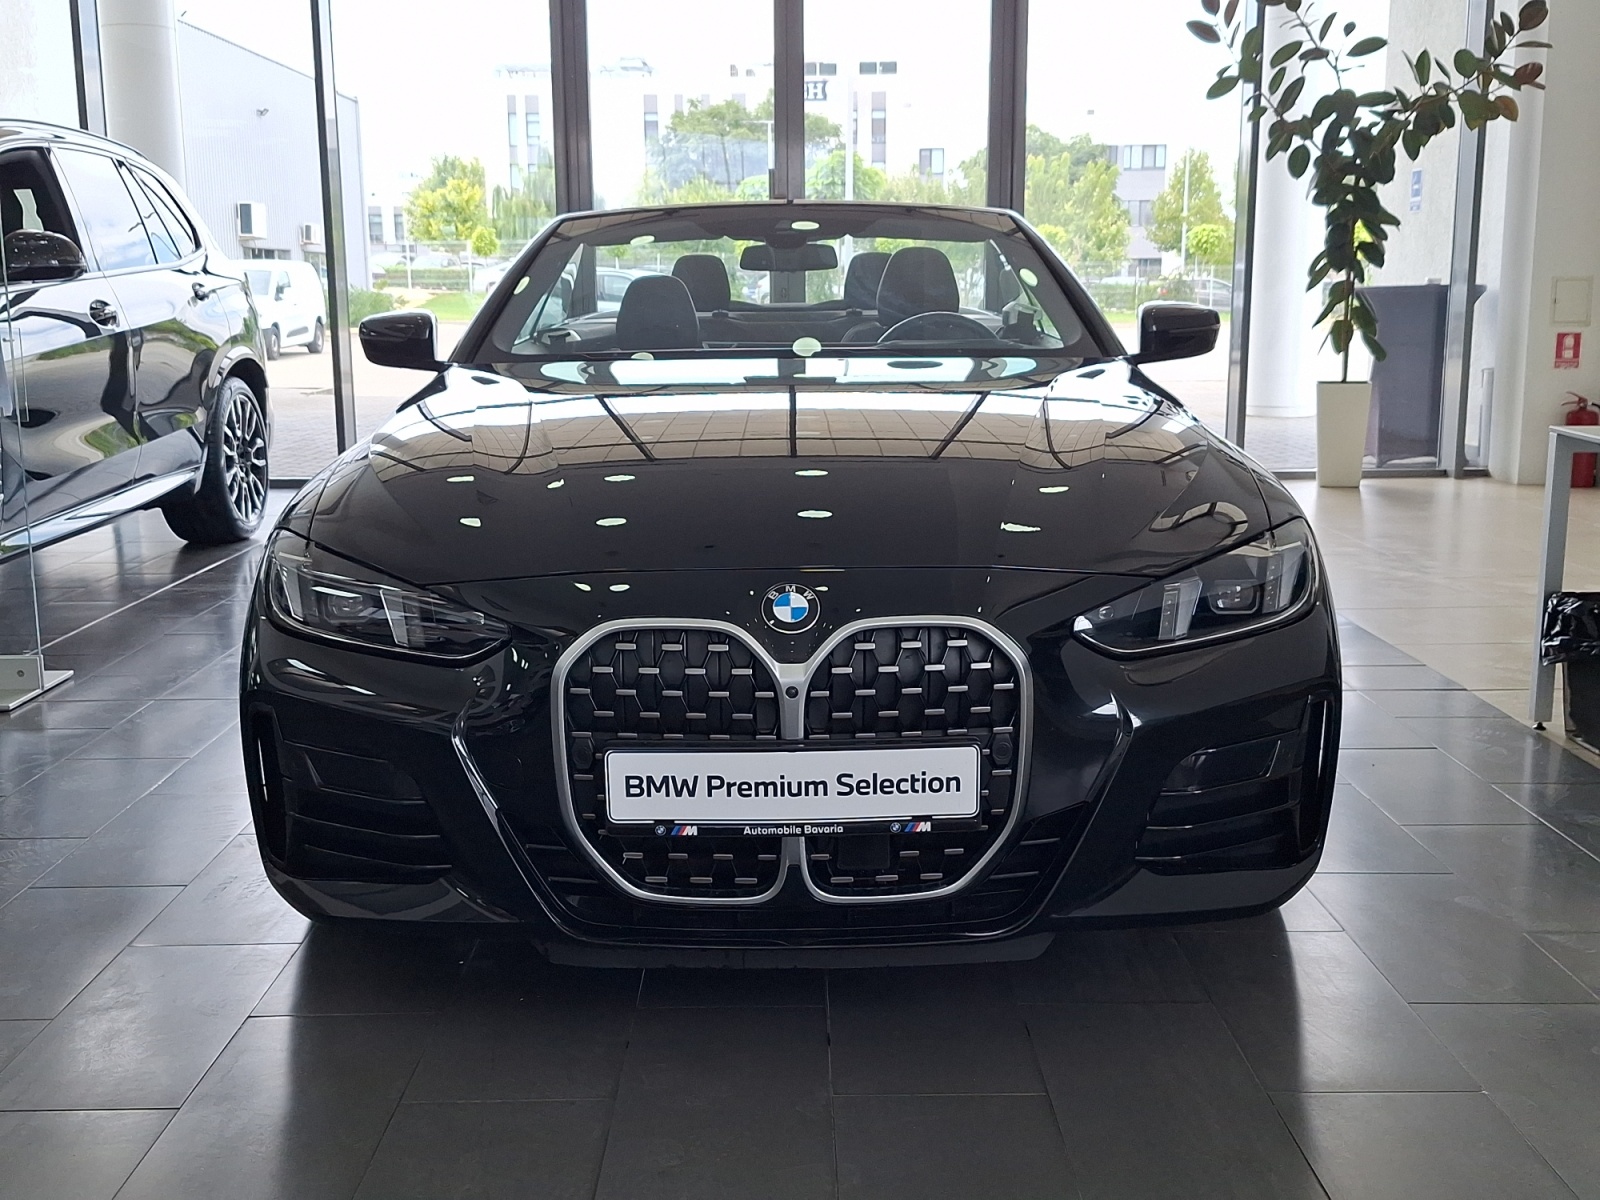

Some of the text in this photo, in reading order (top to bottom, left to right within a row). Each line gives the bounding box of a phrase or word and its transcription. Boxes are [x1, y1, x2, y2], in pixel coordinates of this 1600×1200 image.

[767, 585, 815, 600] BMW
[625, 771, 961, 798] BMW Premium Selection
[743, 824, 844, 835] Automobile Bavaria
